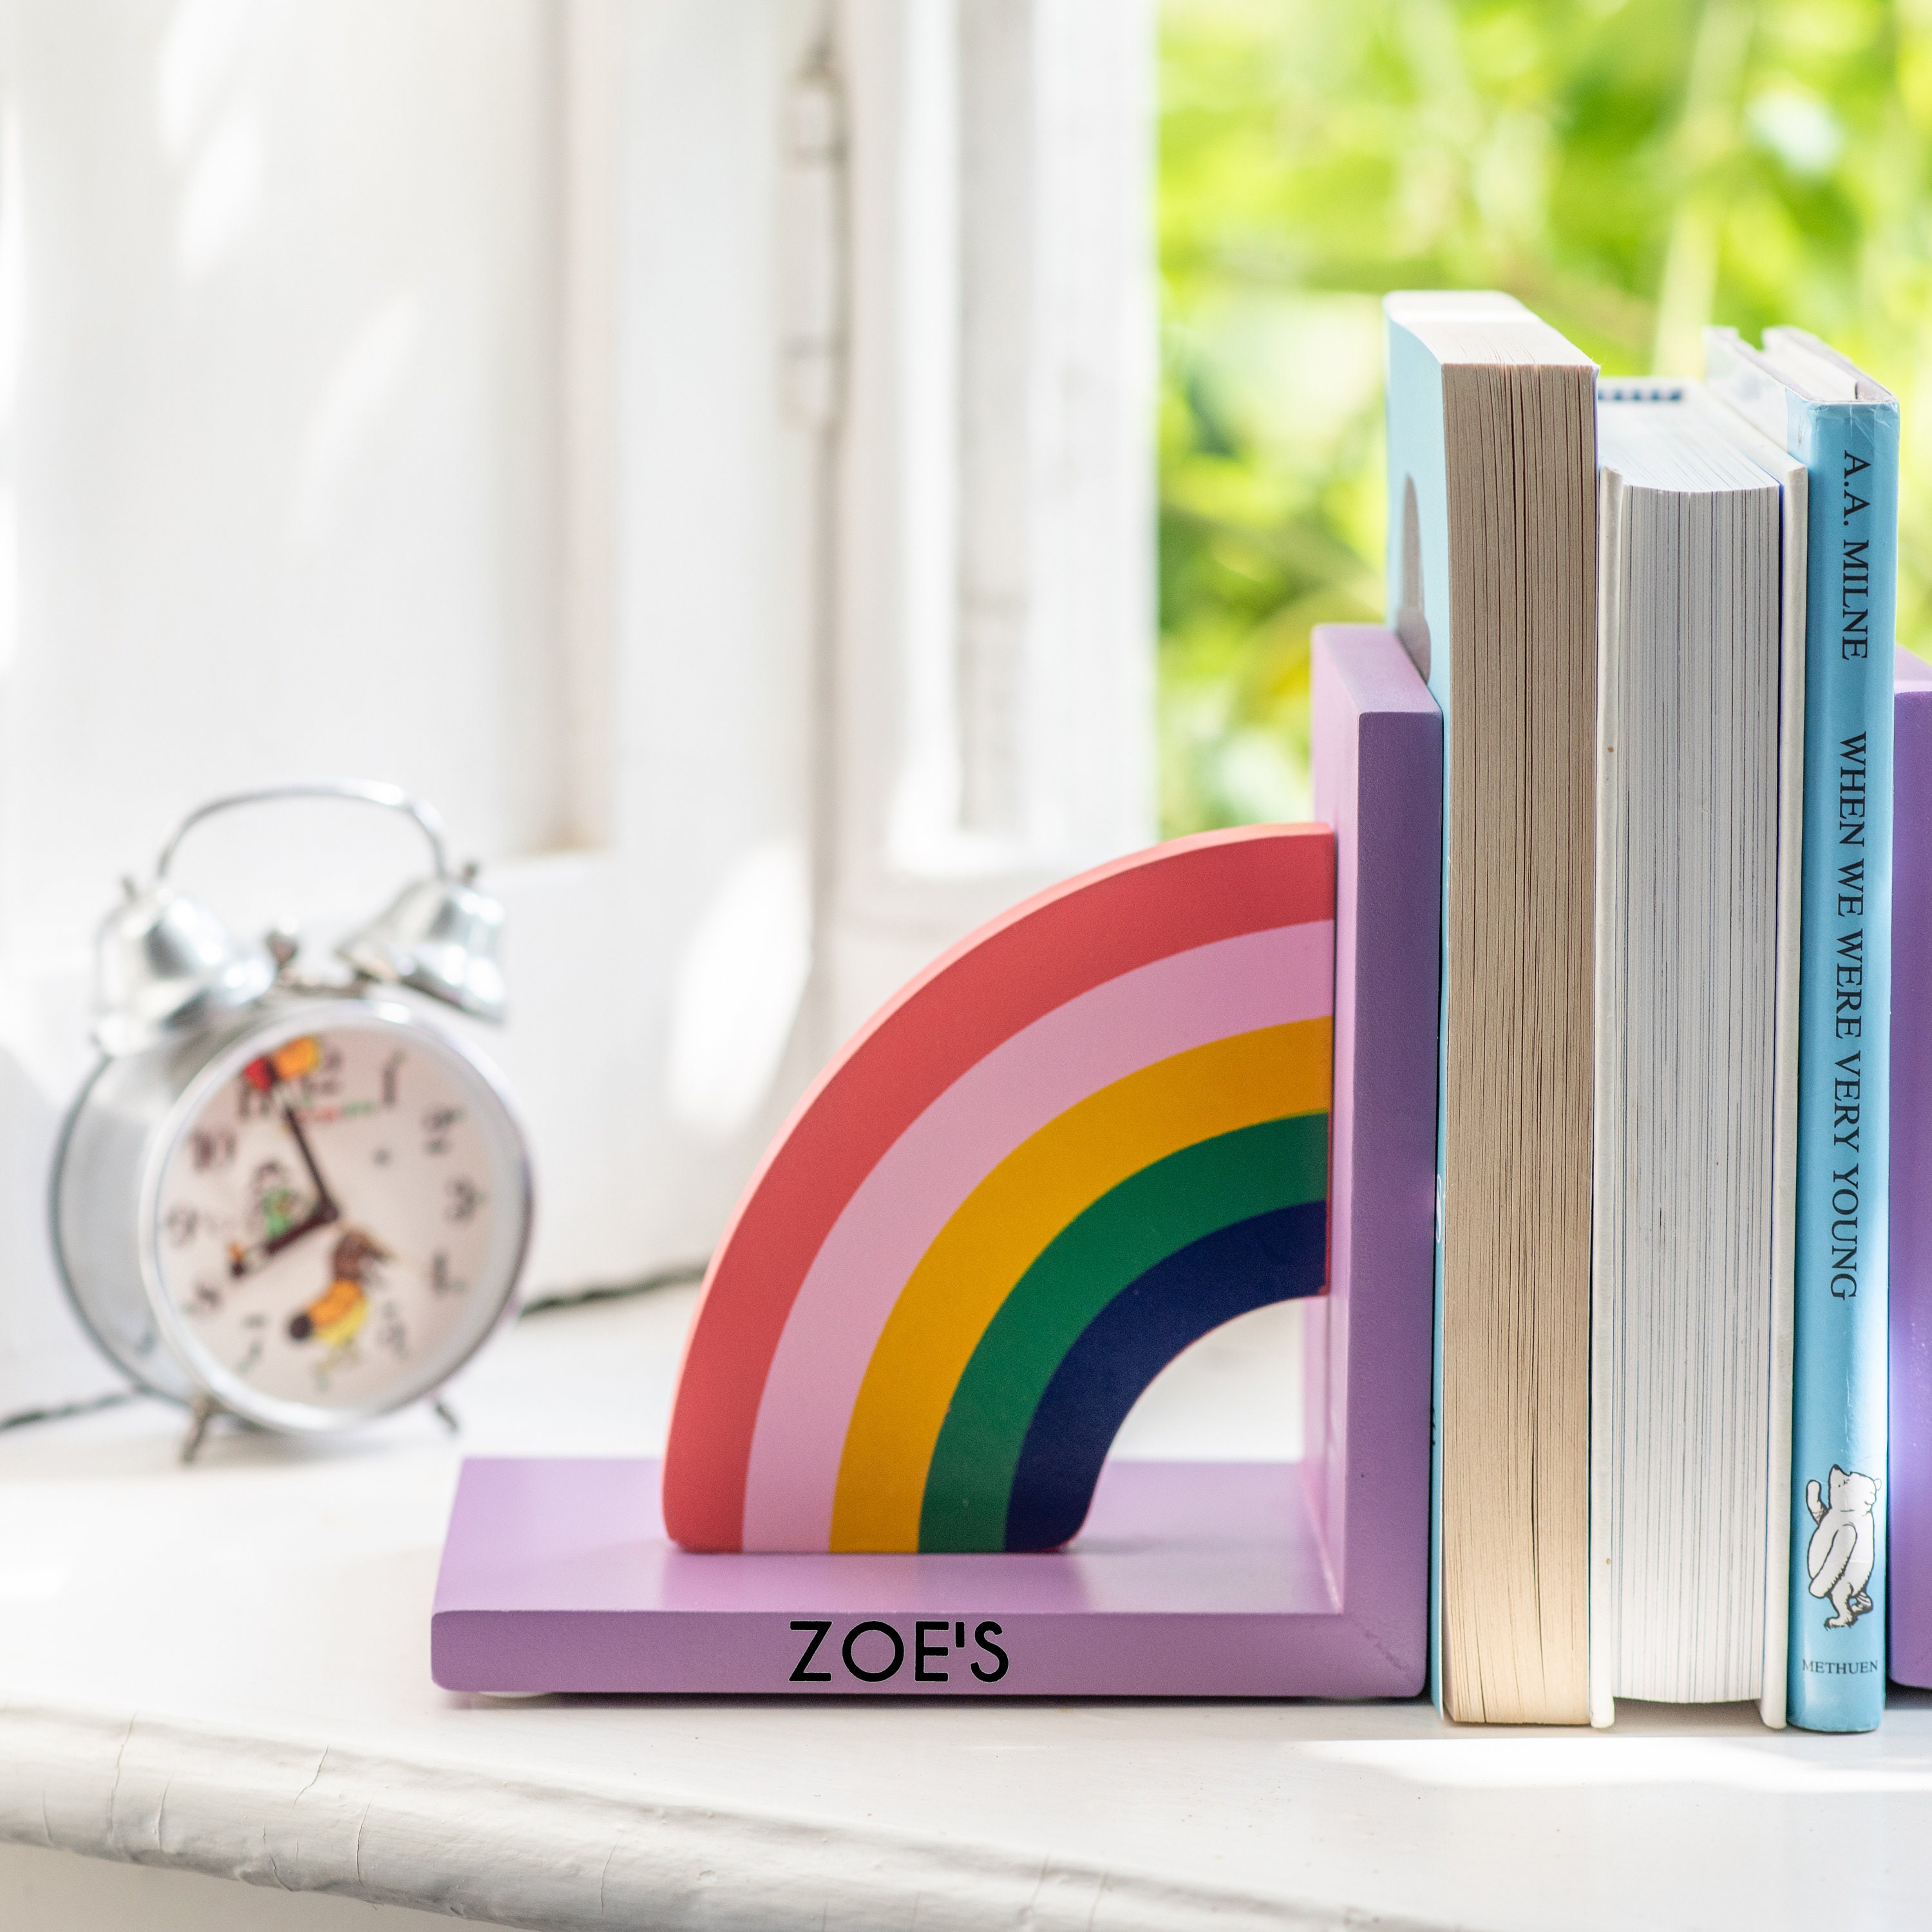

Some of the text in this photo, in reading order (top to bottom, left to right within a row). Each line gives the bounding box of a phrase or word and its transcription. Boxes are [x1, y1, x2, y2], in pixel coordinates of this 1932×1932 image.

[1841, 450, 1871, 661] A.A. MILNE
[1830, 730, 1866, 1301] WHEN WE WERE VERY YOUNG
[789, 1620, 1009, 1683] ZOE'S
[1802, 1659, 1878, 1674] METHUEN
